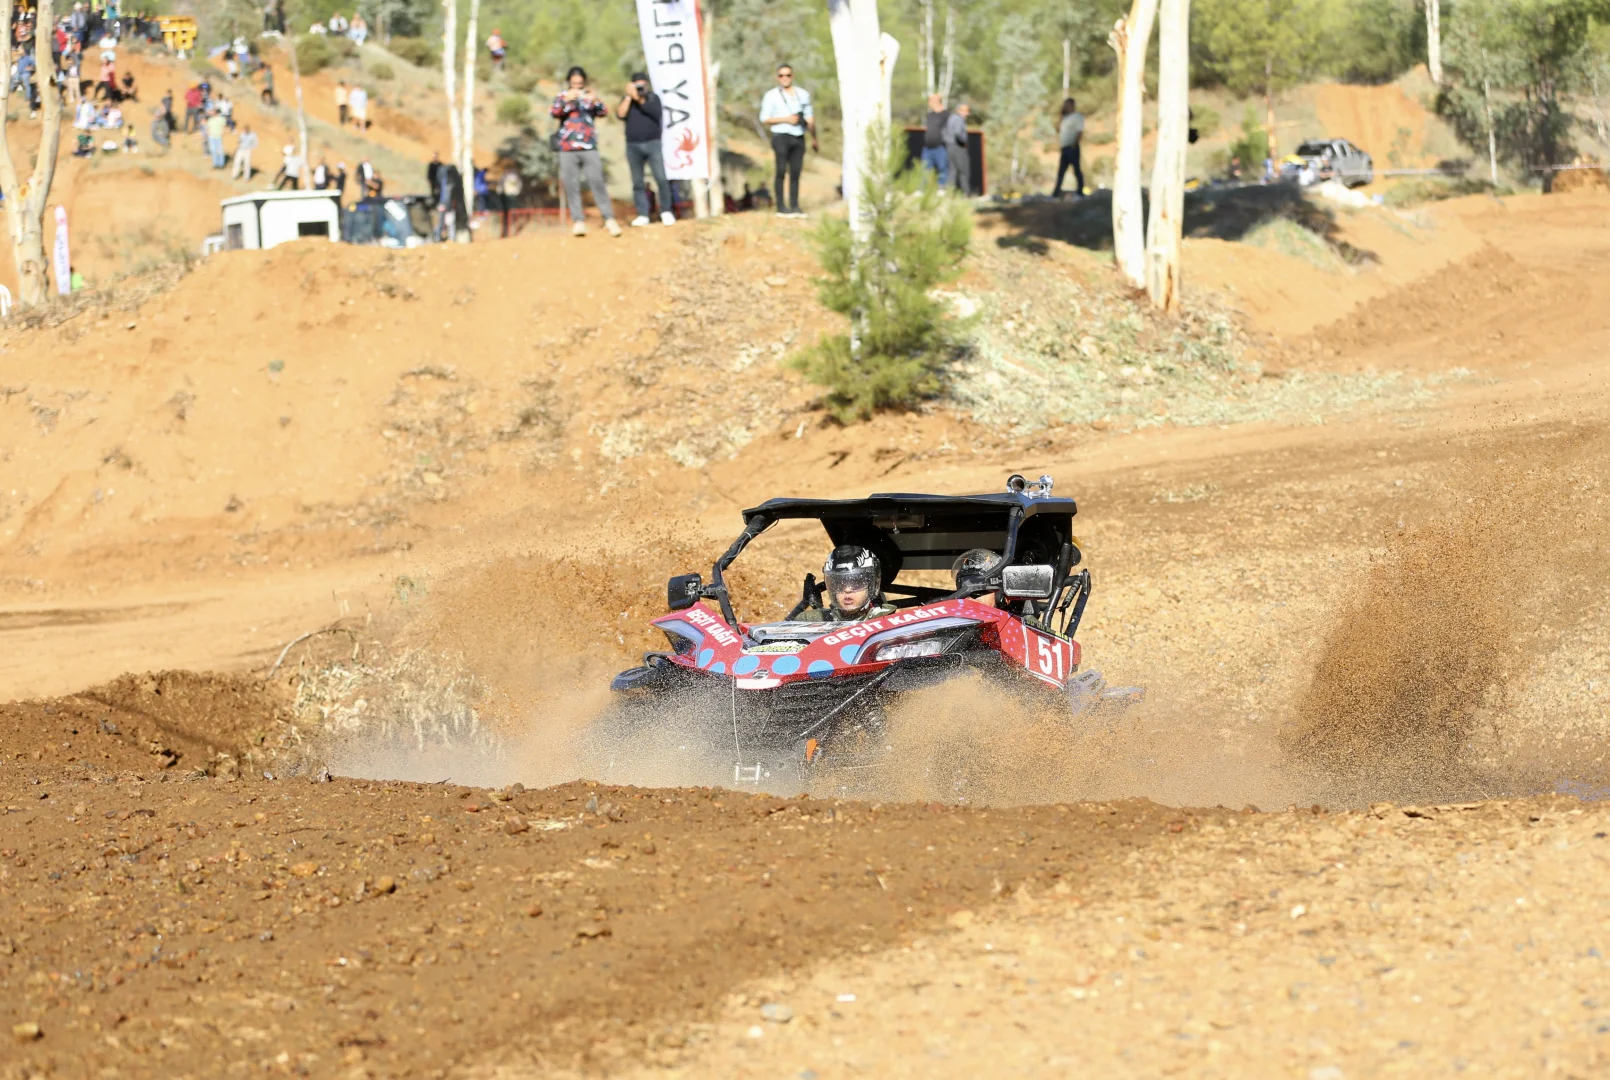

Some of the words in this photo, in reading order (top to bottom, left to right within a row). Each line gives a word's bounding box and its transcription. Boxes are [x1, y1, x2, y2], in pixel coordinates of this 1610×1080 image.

[686, 608, 716, 627] GEÇİT
[705, 623, 738, 647] KAĞIT
[823, 620, 884, 646] GEÇİT
[887, 606, 948, 626] KAĞIT
[1038, 635, 1063, 680] 51
